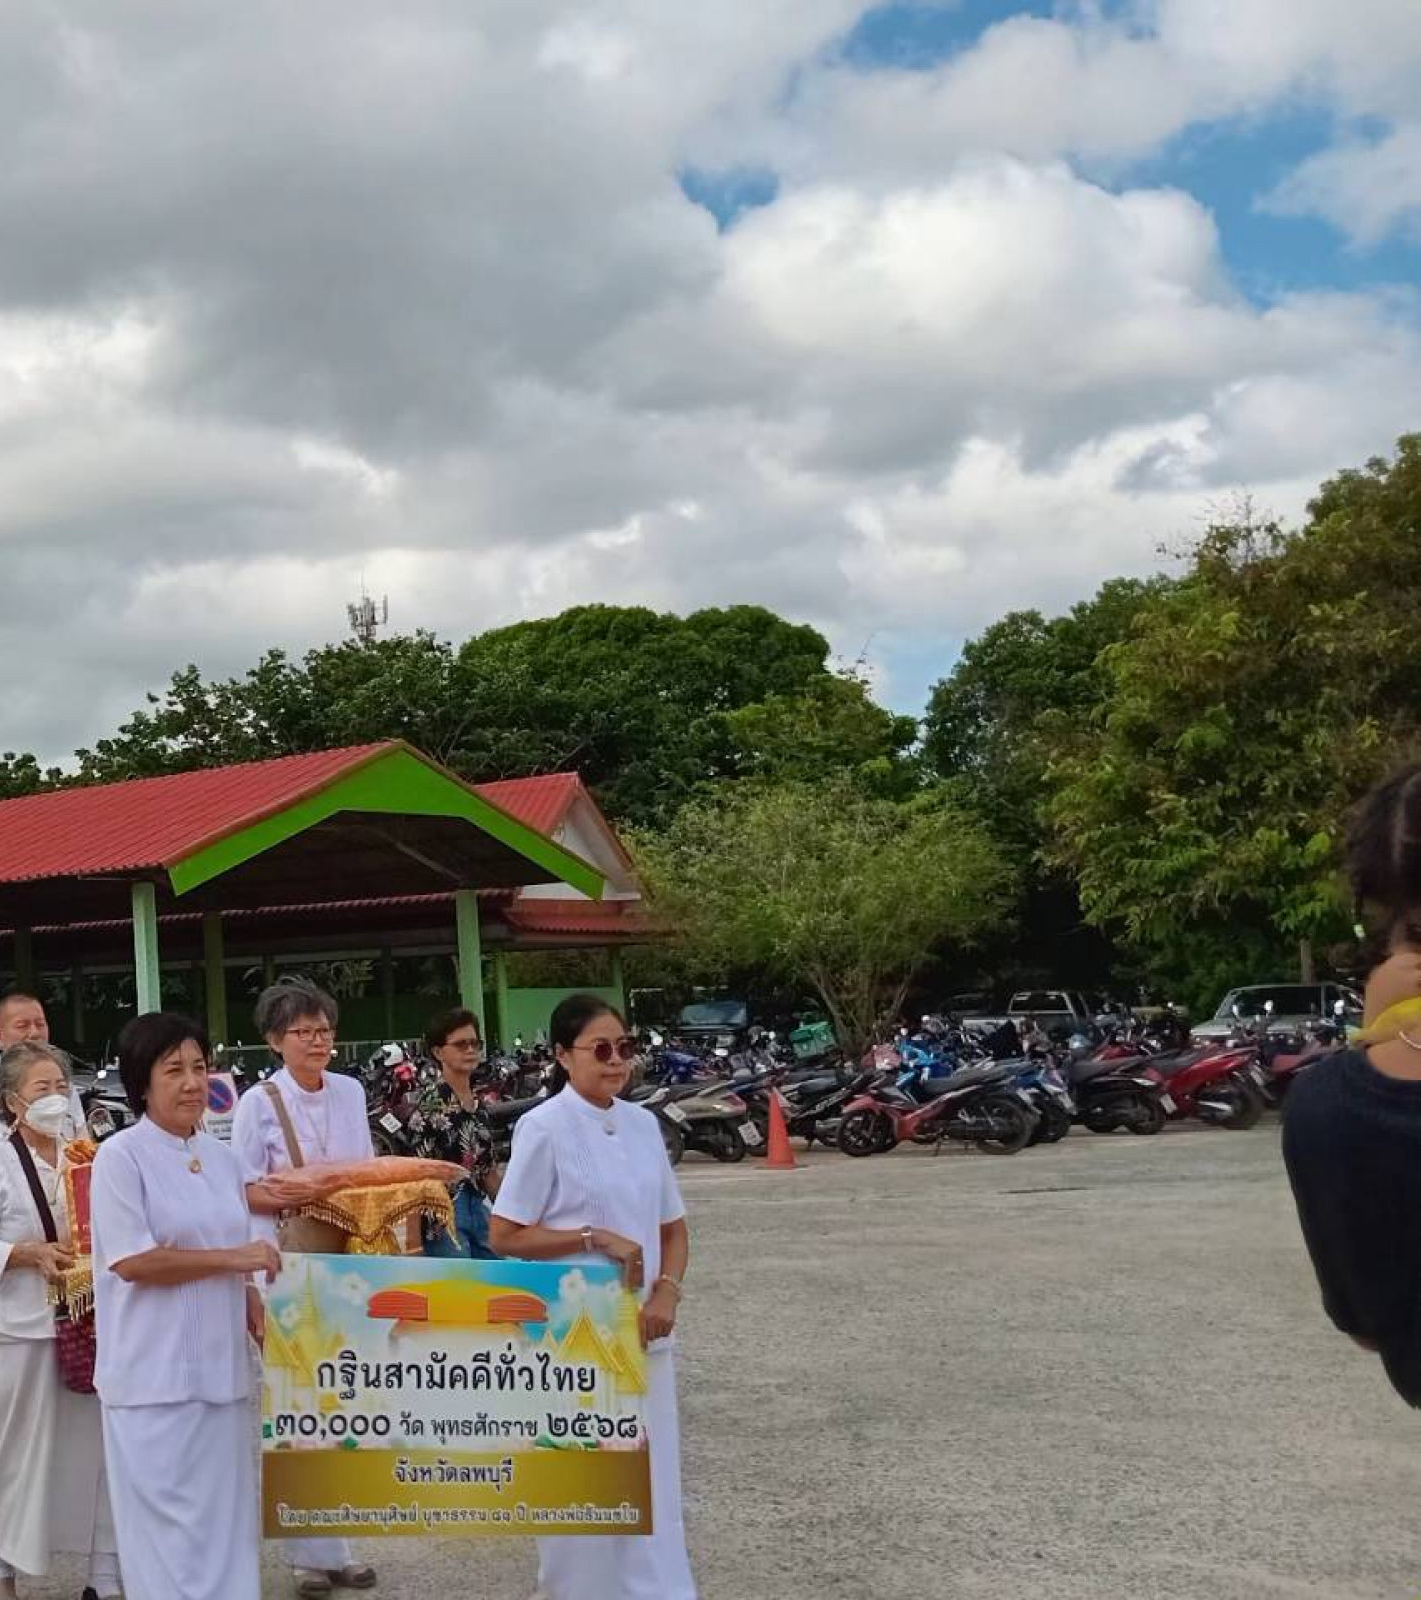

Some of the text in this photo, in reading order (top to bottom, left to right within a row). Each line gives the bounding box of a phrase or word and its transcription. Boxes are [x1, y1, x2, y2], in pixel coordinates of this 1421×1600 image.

[317, 1342, 596, 1400] กฐินสามัคคีทั่วไทย
[275, 1411, 639, 1444] ๓๐,๐๐๐ วัด พุทธศักราช ๒๕๖๘
[395, 1457, 513, 1492] จังหวัดลพบุรี
